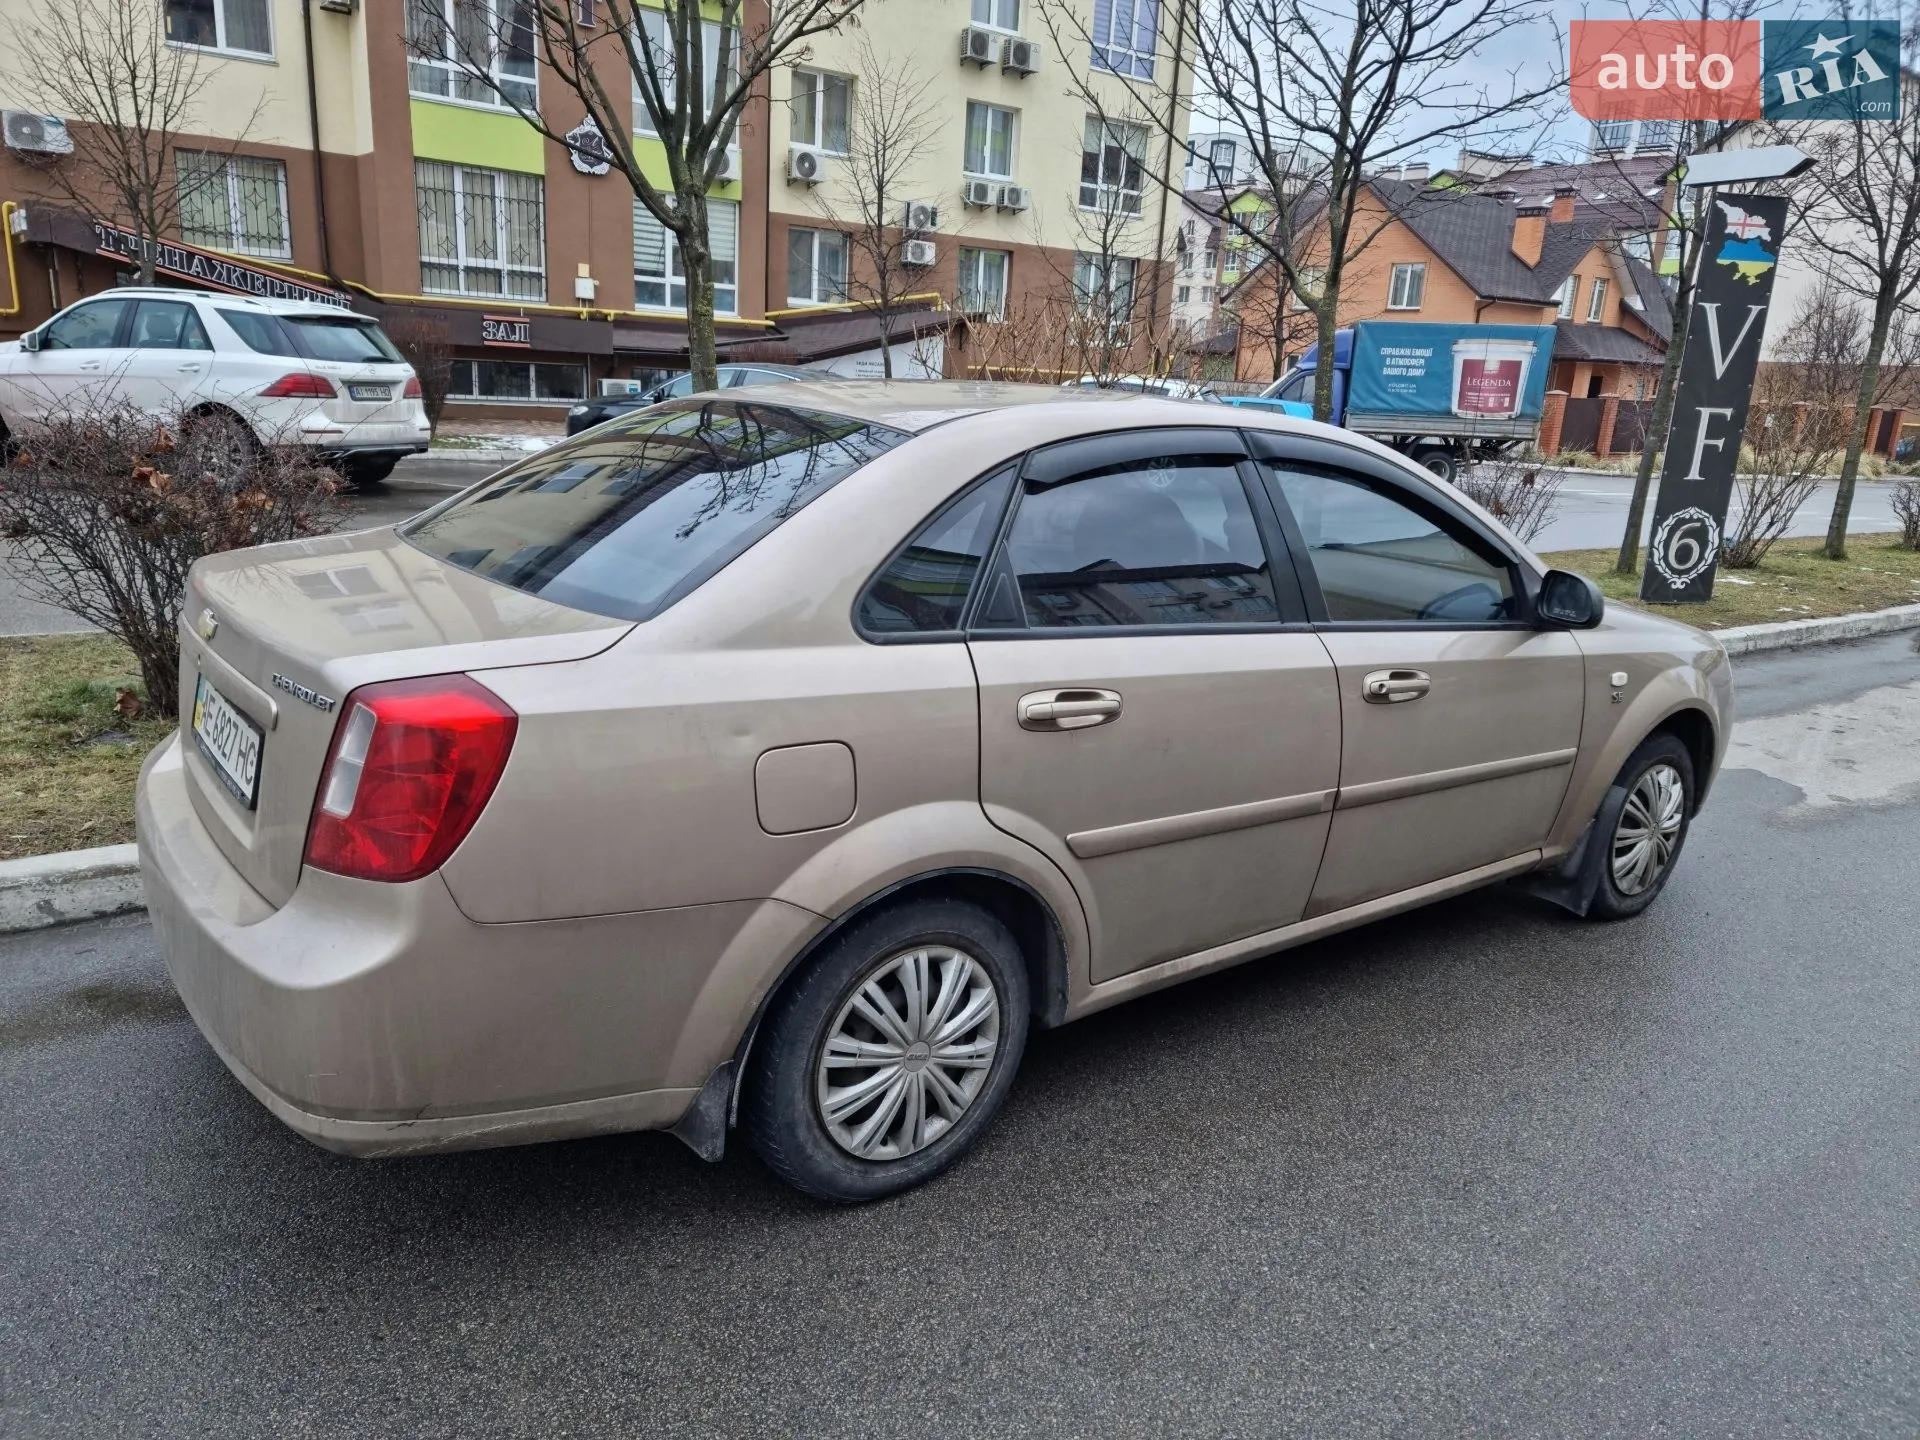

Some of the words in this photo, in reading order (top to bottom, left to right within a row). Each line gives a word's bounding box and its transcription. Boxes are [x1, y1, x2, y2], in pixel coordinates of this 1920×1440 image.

[482, 320, 530, 342] ЗАЛ
[1467, 376, 1511, 387] LEGENDA
[1668, 522, 1702, 570] 6
[272, 672, 336, 713] CHEVROLET
[212, 706, 239, 763] 6827
[235, 730, 257, 785] HC
